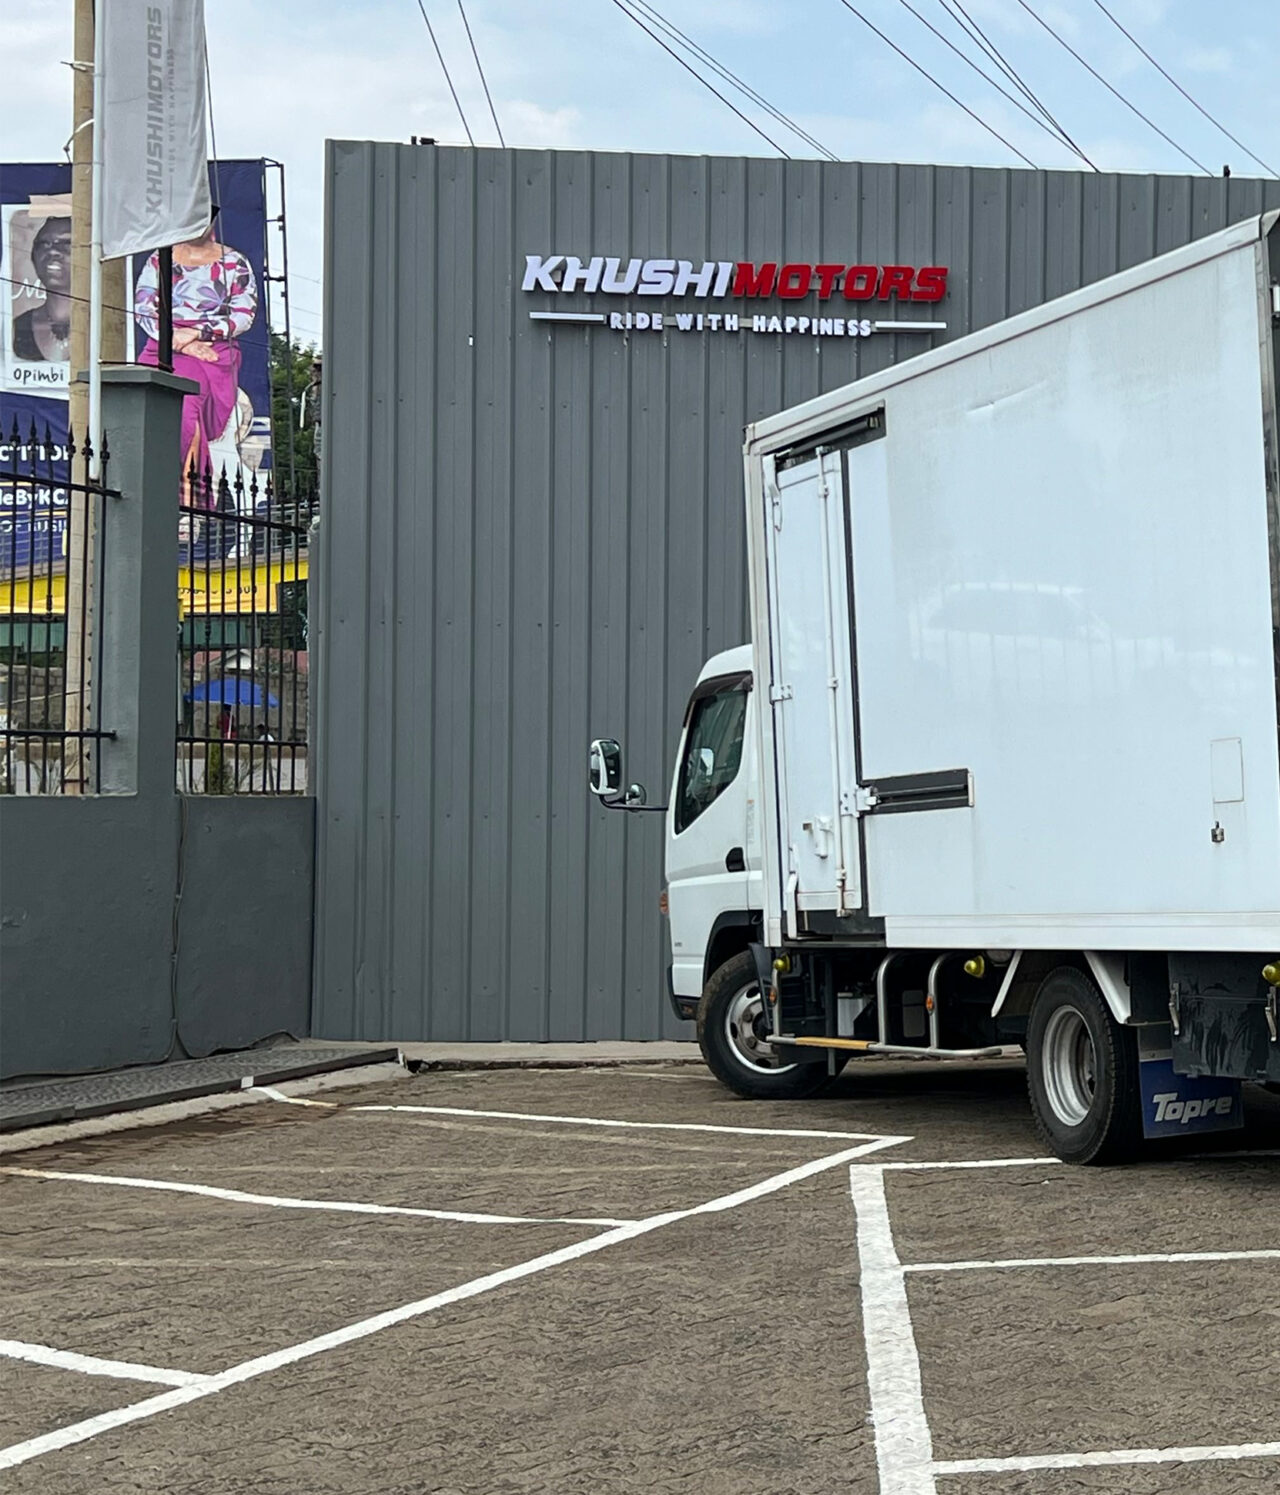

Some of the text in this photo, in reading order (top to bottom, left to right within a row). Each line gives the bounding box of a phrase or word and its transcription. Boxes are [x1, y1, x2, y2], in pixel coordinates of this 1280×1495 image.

[609, 312, 872, 337] RIDE WITH HAPPINESS
[1152, 1092, 1232, 1123] Topre
